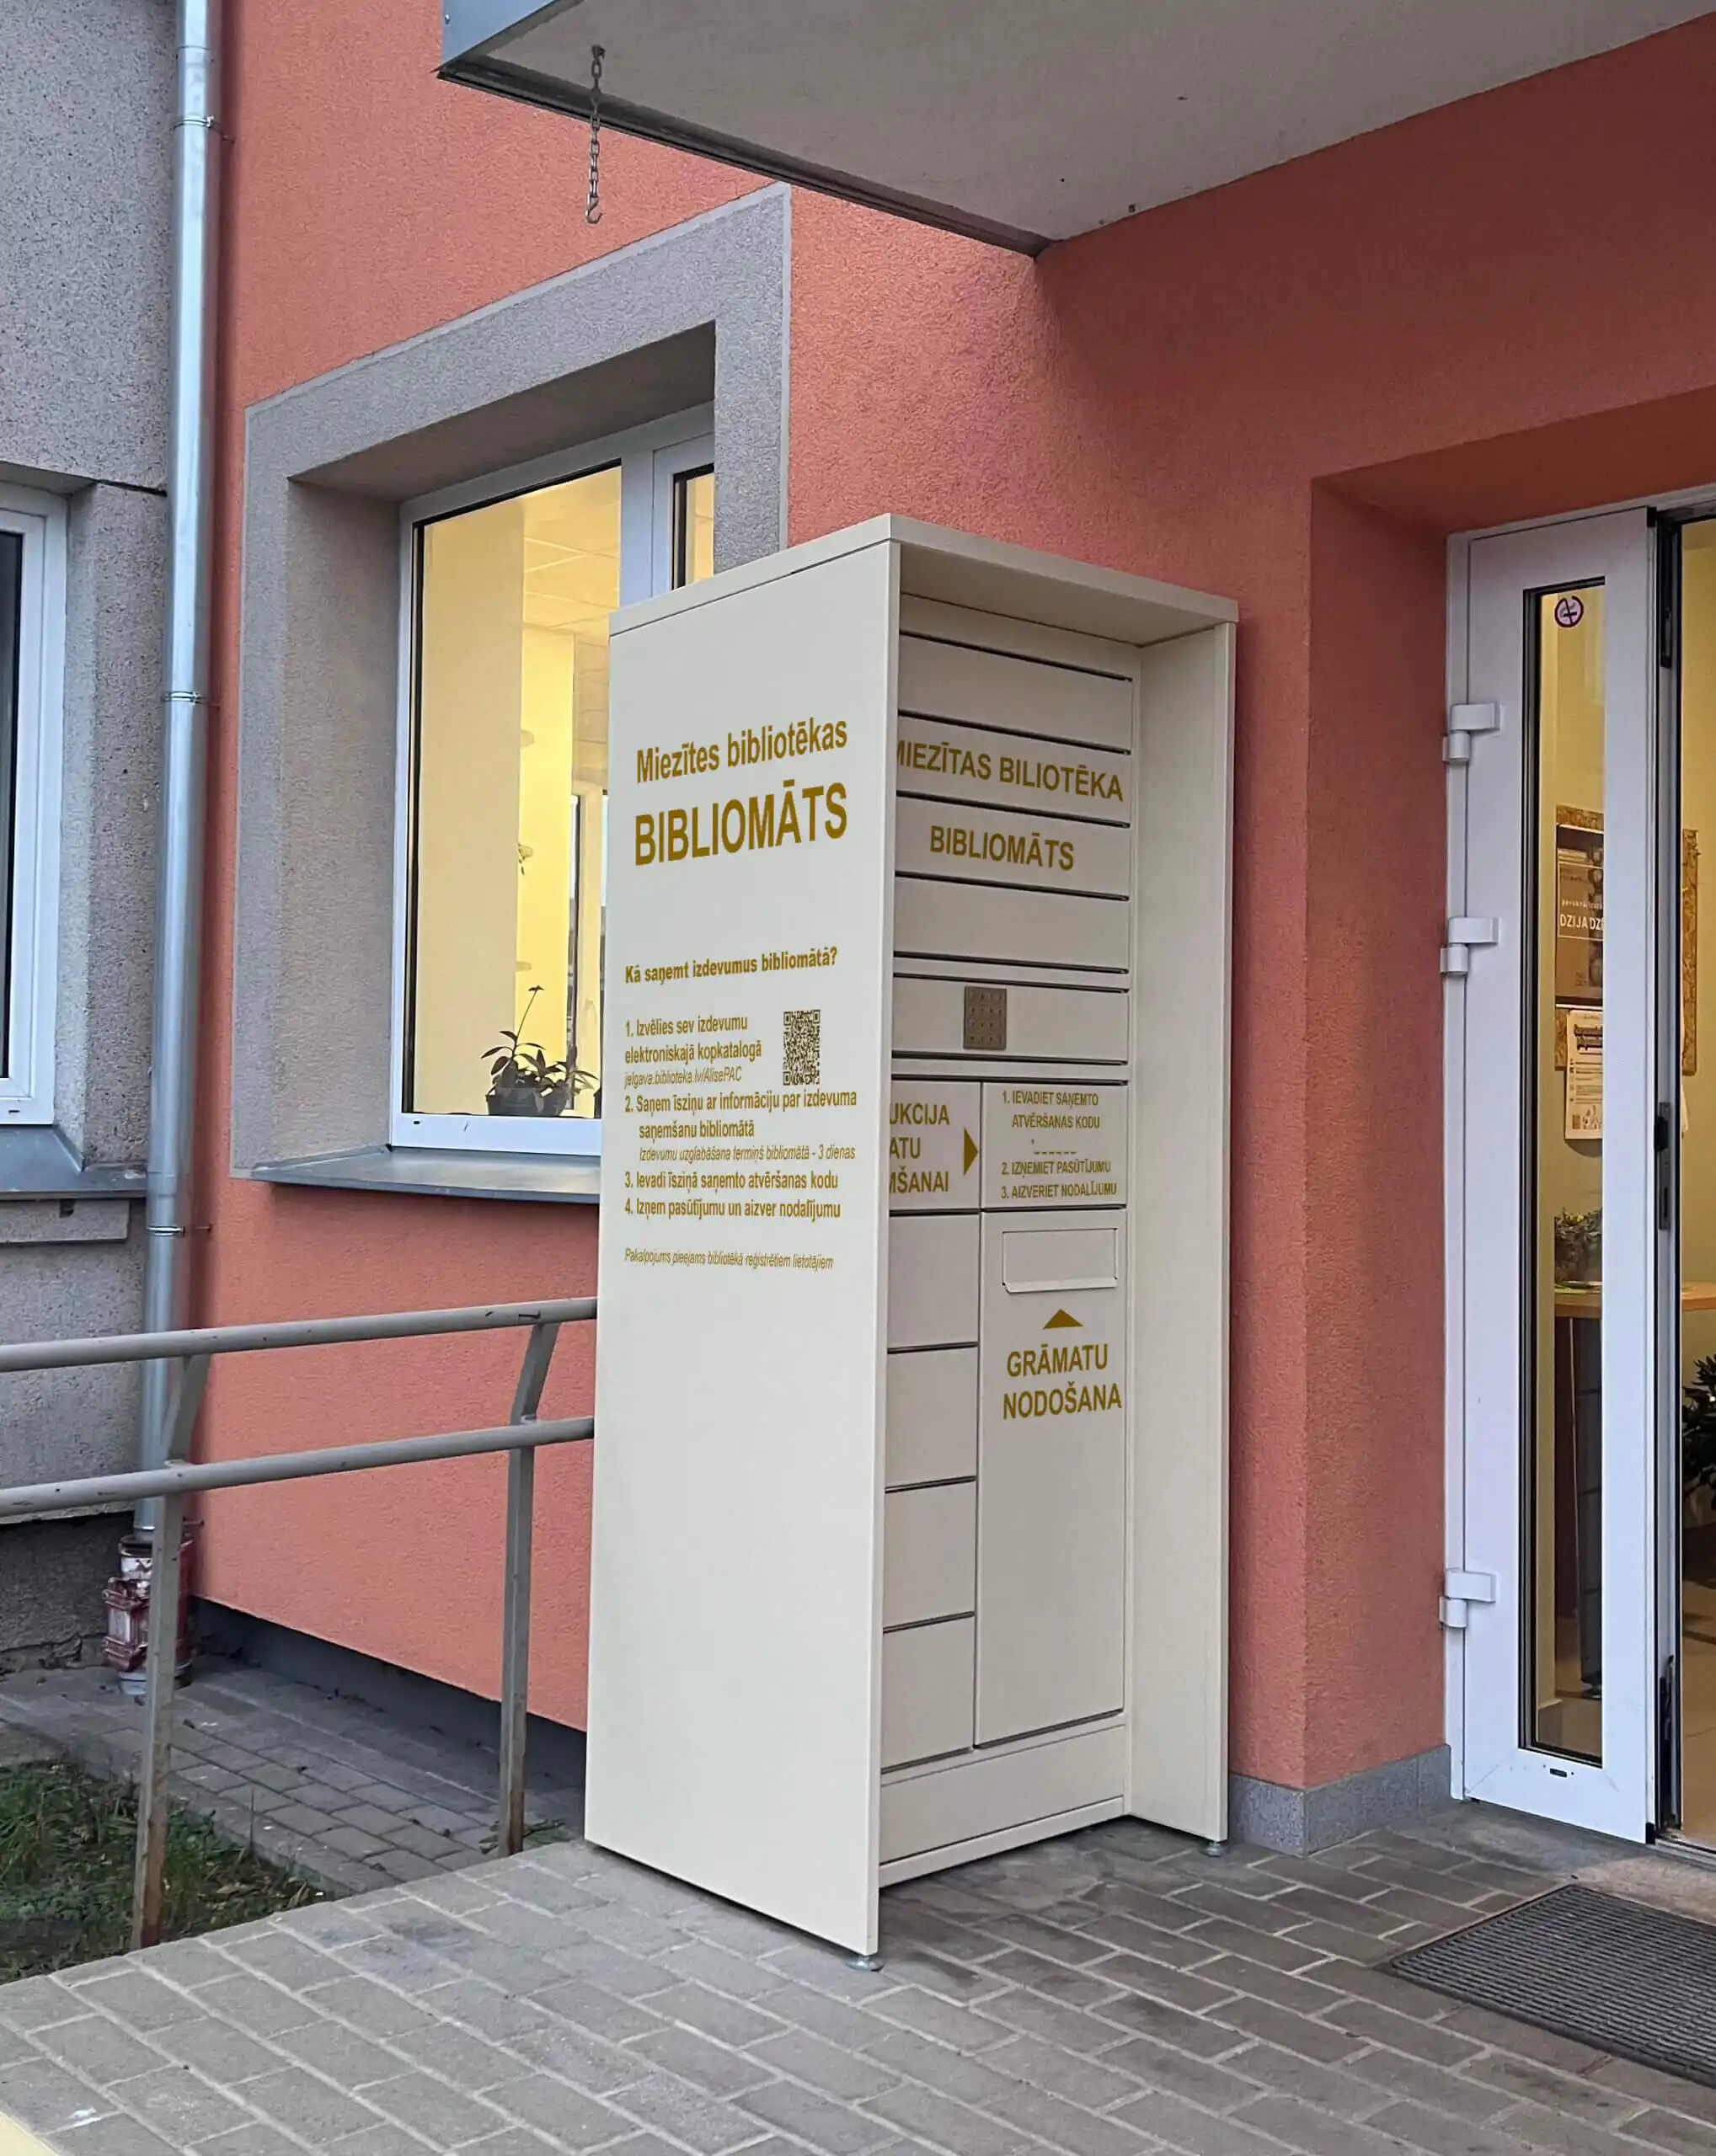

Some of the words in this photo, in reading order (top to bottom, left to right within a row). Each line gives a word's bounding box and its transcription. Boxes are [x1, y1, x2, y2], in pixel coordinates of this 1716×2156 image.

[637, 741, 719, 783] Miezītes
[727, 718, 847, 767] bibliotēkas
[999, 756, 1123, 802] BILIOTĒKA
[635, 779, 847, 866] BIBLIOMĀTS
[930, 825, 1074, 871] BIBLIOMĀTS
[625, 964, 641, 984] Kā
[644, 962, 689, 985] saņemt
[692, 958, 758, 978] izdevumus
[762, 946, 837, 972] bibliomātā?
[626, 1019, 634, 1037] 1.
[637, 1017, 673, 1037] Izvēlies
[676, 1020, 694, 1034] sev
[698, 1015, 747, 1033] izdevumu
[625, 1043, 694, 1065] elektroniskajā
[698, 1039, 762, 1064] kopkatalogā
[625, 1095, 633, 1113] 2.
[636, 1094, 671, 1117] Saņem
[674, 1092, 703, 1116] īsziņu
[706, 1097, 717, 1111] ar
[719, 1090, 779, 1113] informāciju
[783, 1093, 801, 1112] par
[804, 1088, 857, 1107] izdevuma
[1002, 1091, 1010, 1103] 1.
[1013, 1091, 1054, 1105] IEVADIET
[1056, 1091, 1099, 1108] SAŅEMTO
[639, 1120, 697, 1144] saņemšanu
[700, 1119, 754, 1138] bibliomātā
[1012, 1112, 1073, 1129] ATVĒRŠANAS
[1075, 1115, 1100, 1129] KODU
[818, 1144, 824, 1160] 3
[826, 1144, 856, 1160] dienas
[1002, 1162, 1009, 1175] 2.
[624, 1171, 633, 1188] 3.
[637, 1171, 666, 1188] Ievadi
[668, 1171, 698, 1194] īsziņā
[701, 1171, 746, 1193] saņemto
[748, 1170, 807, 1188] atvēršanas
[810, 1170, 838, 1189] kodu
[1001, 1186, 1009, 1199] 3.
[1011, 1184, 1059, 1199] AIZVERIET
[625, 1198, 633, 1215] 4.
[637, 1198, 666, 1219] Izņem
[729, 1204, 741, 1216] un
[745, 1199, 777, 1218] aizver
[779, 1199, 841, 1223] nodalījumu
[1007, 1343, 1108, 1377] GRĀMATU
[1003, 1381, 1122, 1420] NODOŠANA
